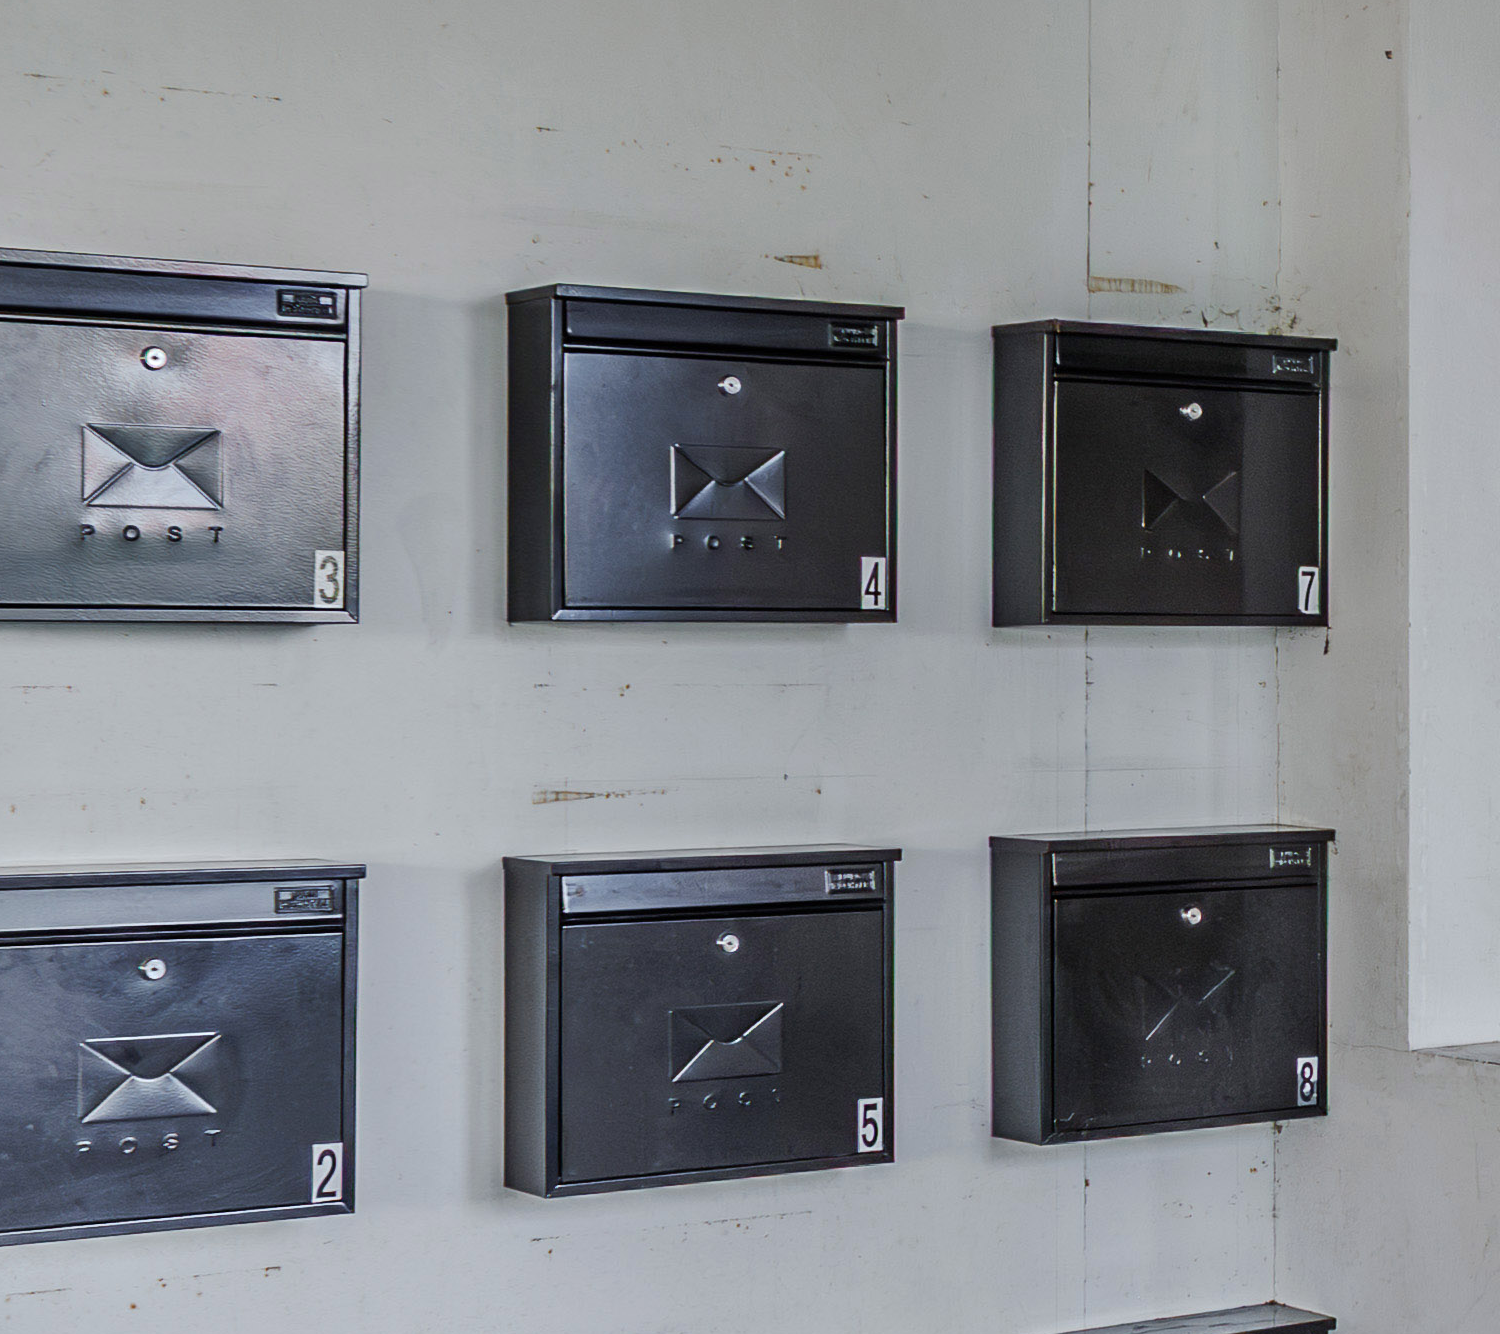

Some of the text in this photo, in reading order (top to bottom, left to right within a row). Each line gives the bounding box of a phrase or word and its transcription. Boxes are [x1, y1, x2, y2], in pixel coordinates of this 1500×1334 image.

[79, 523, 224, 544] POST
[319, 555, 340, 604] 3
[863, 560, 882, 607] 4
[1301, 570, 1316, 612] 7
[1299, 1061, 1314, 1103] 8
[76, 1128, 222, 1155] POST
[861, 1102, 879, 1148] 5
[316, 1148, 337, 1198] 2
